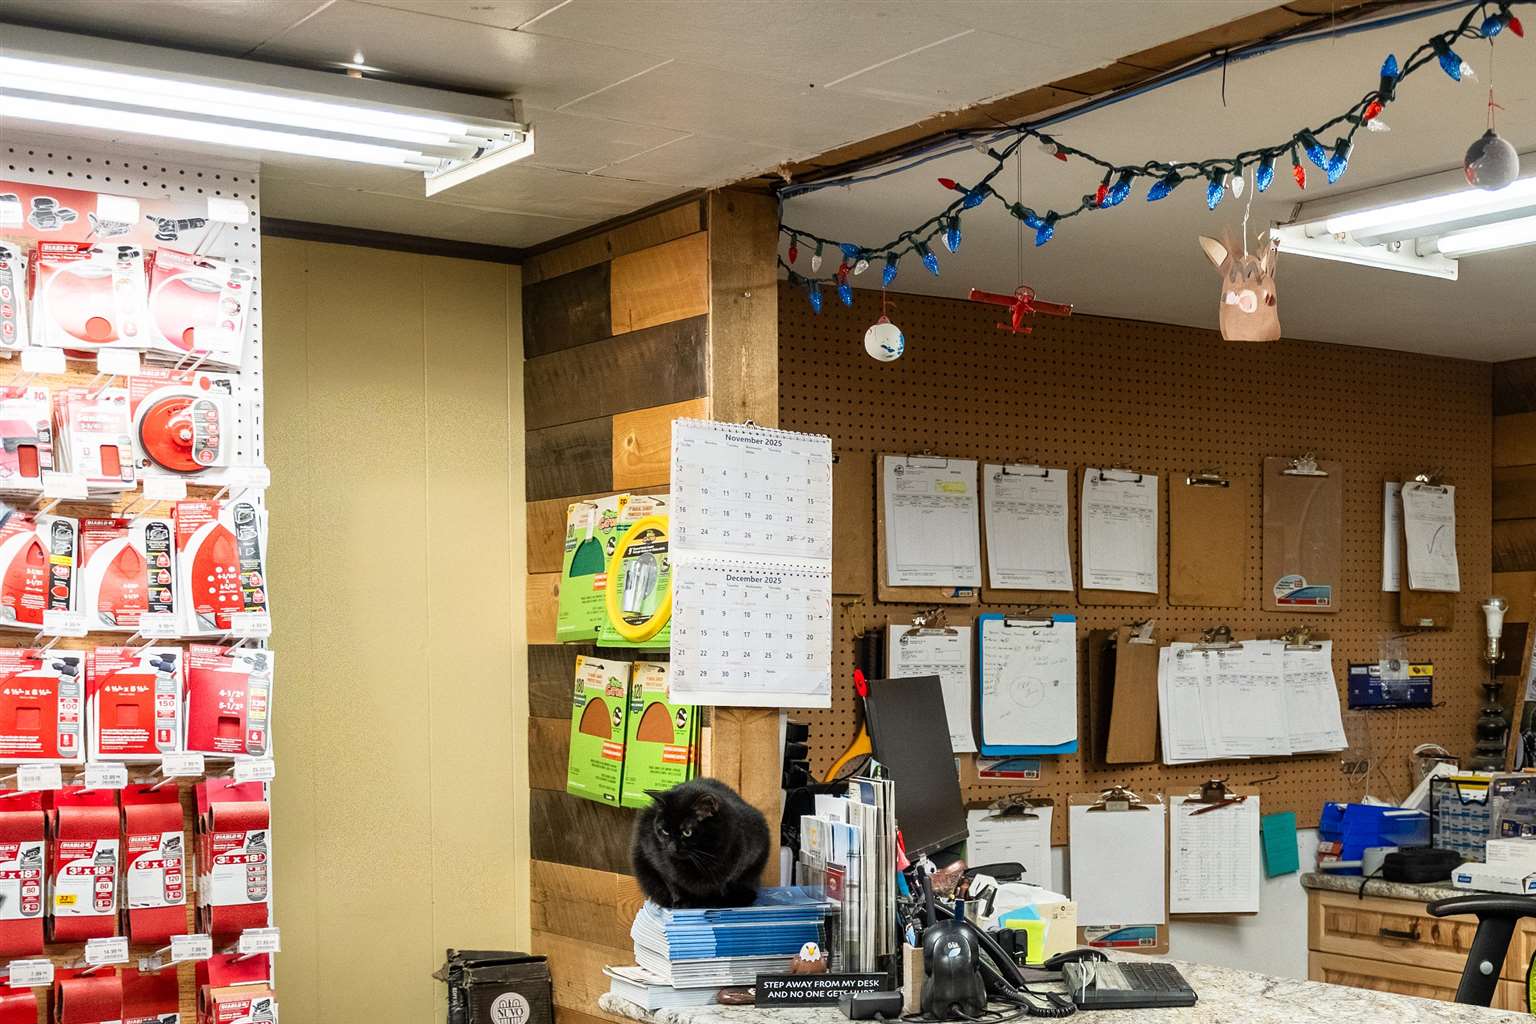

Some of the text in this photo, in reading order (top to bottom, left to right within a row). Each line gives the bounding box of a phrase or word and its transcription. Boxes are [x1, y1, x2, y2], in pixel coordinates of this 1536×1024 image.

[725, 434, 782, 447] November 2025
[726, 574, 782, 584] December 2025
[786, 980, 812, 988] AWAY
[814, 980, 840, 988] FROM
[842, 980, 856, 988] MY
[858, 979, 880, 988] DESK
[768, 990, 790, 998] AND
[792, 990, 804, 998] NO
[806, 990, 824, 998] ONE
[498, 1008, 524, 1018] NUVO
